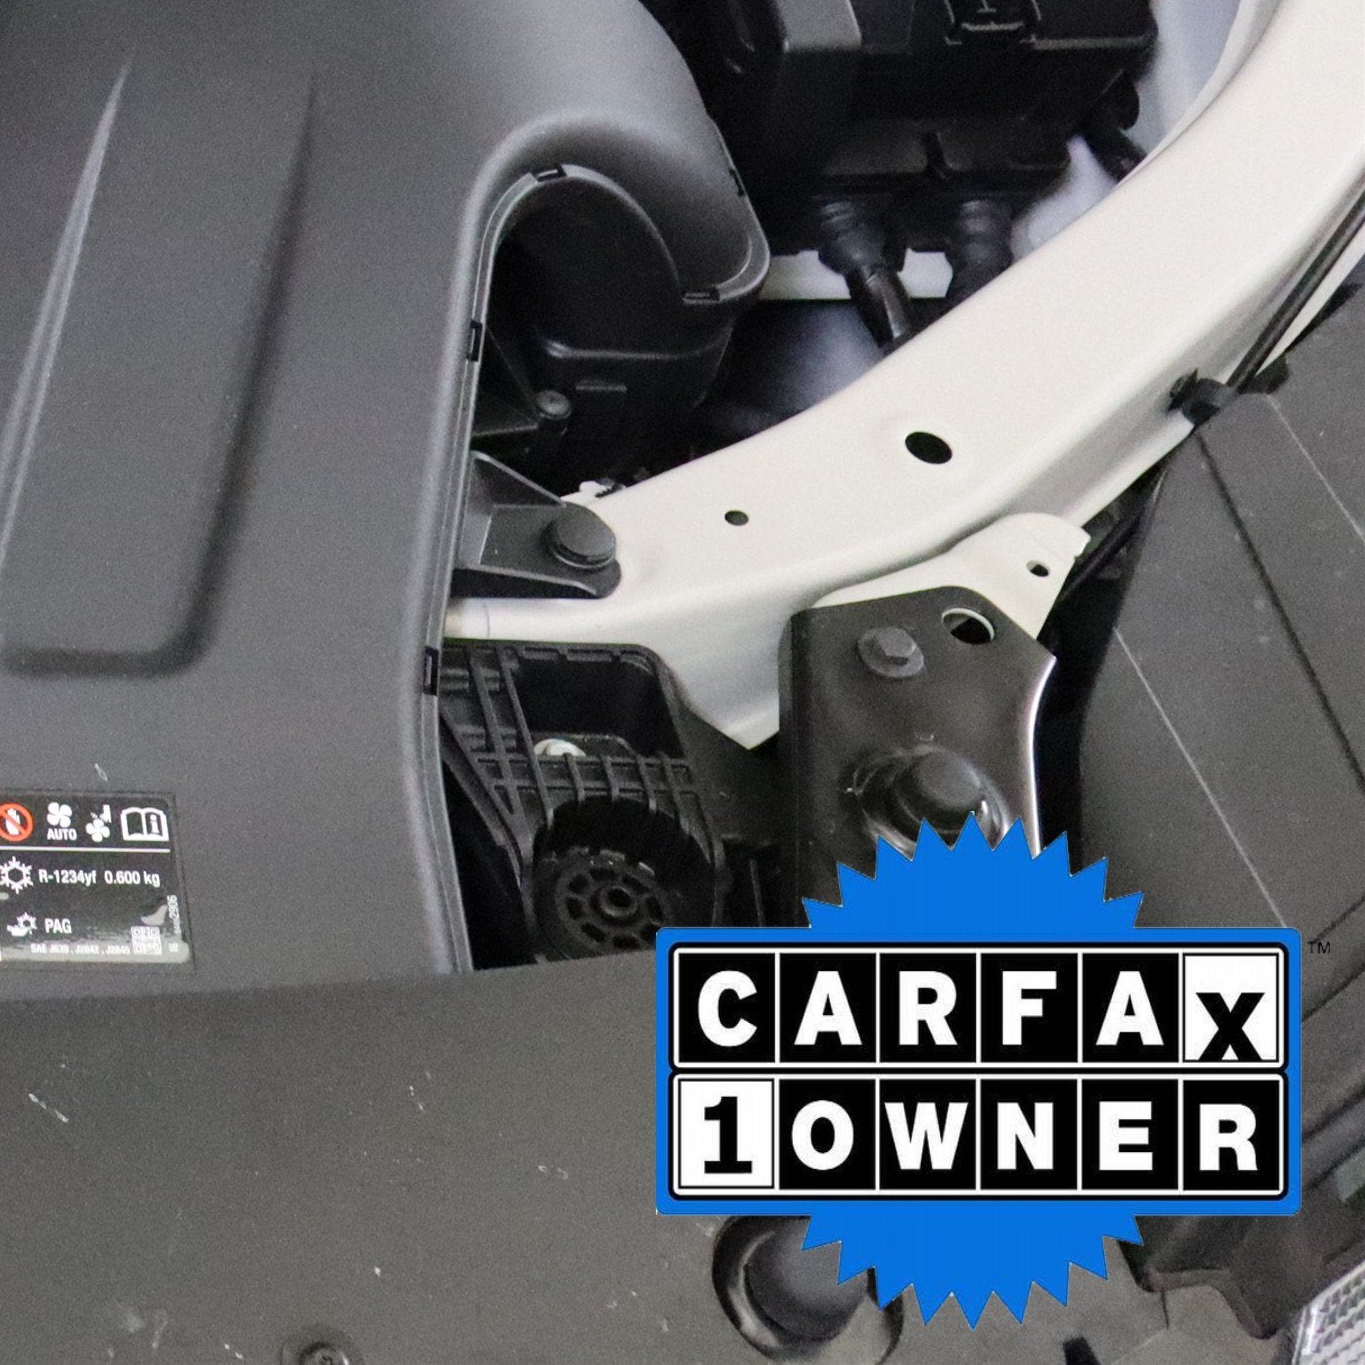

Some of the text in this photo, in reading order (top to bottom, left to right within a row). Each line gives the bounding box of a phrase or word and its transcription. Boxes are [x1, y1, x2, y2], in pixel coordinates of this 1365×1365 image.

[46, 828, 78, 841] AUTO
[38, 870, 161, 888] R-1234yf 0.600 kg
[44, 918, 72, 934] PAG
